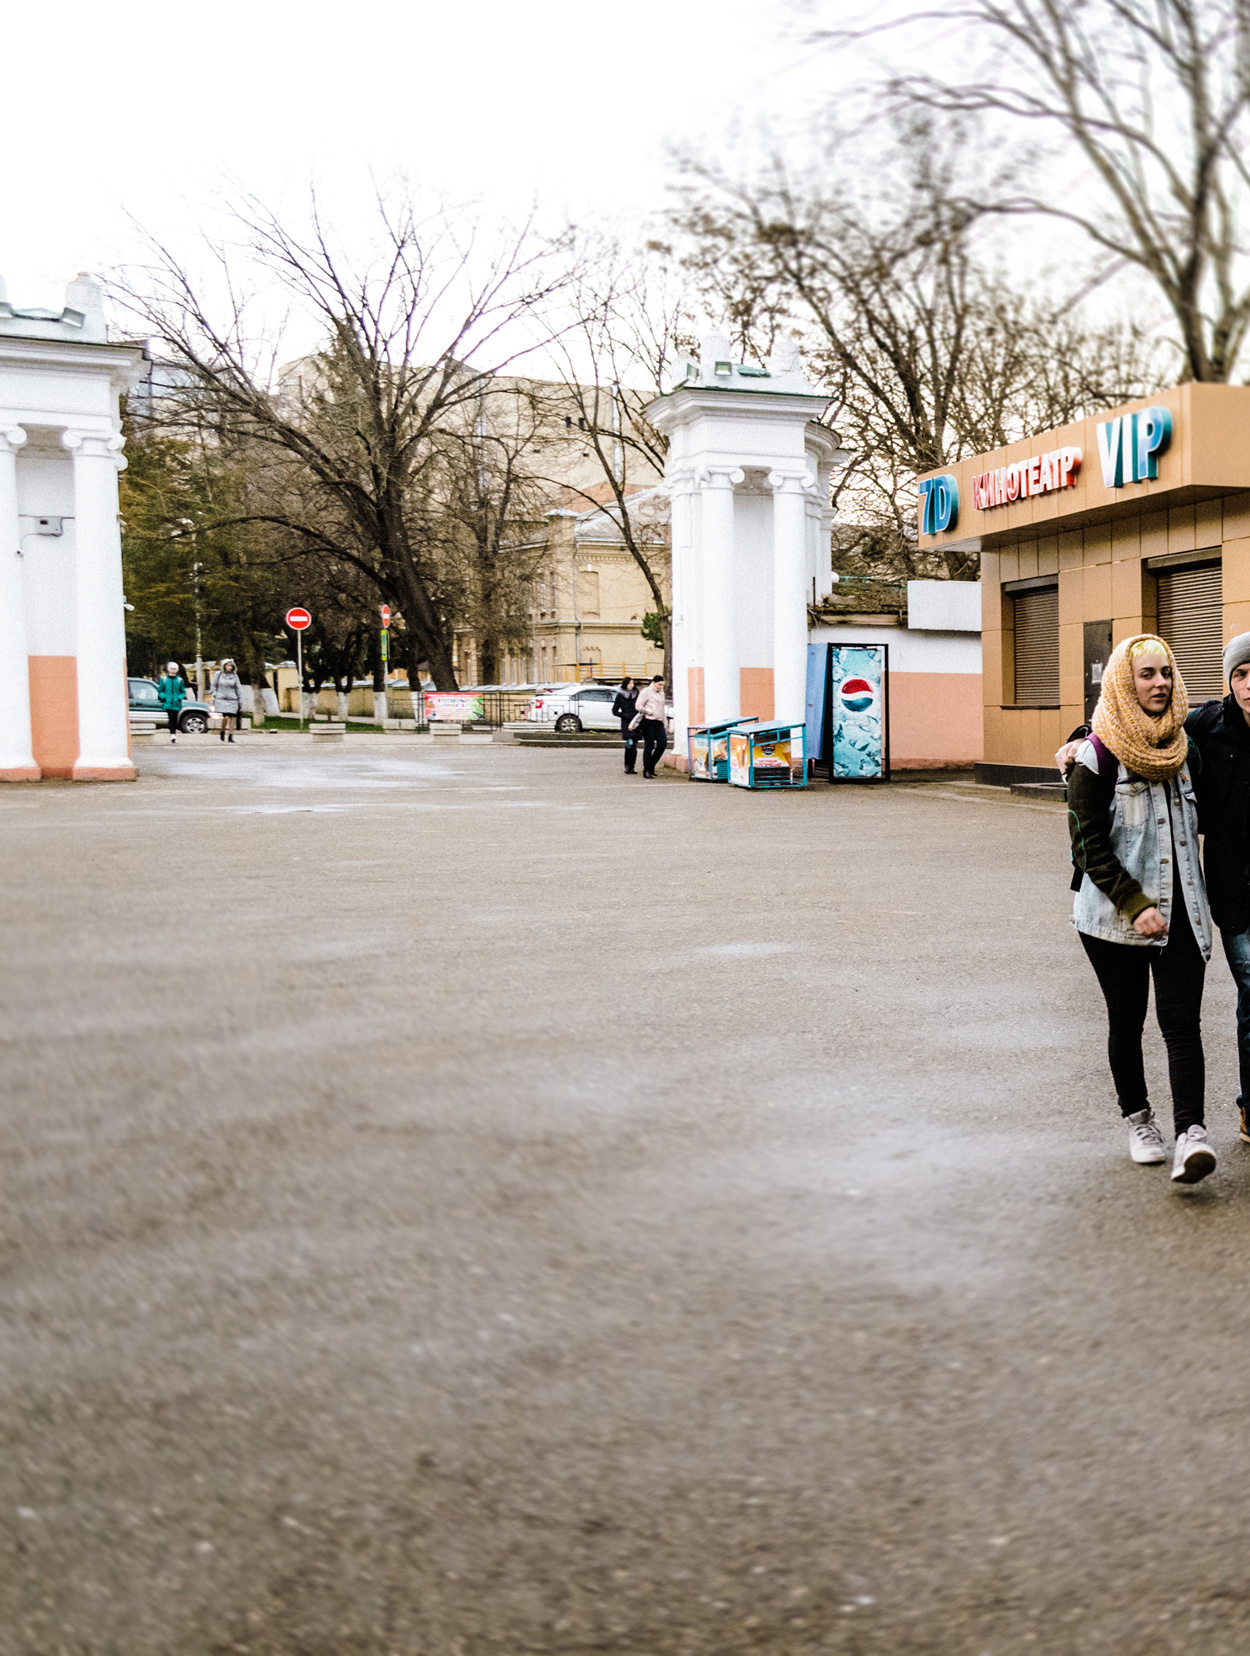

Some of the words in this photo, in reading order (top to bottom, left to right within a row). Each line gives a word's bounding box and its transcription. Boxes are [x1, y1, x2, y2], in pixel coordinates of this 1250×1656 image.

[973, 447, 1083, 511] КИНОТЕАТР
[1096, 406, 1172, 488] VIP
[919, 474, 958, 535] 7D
